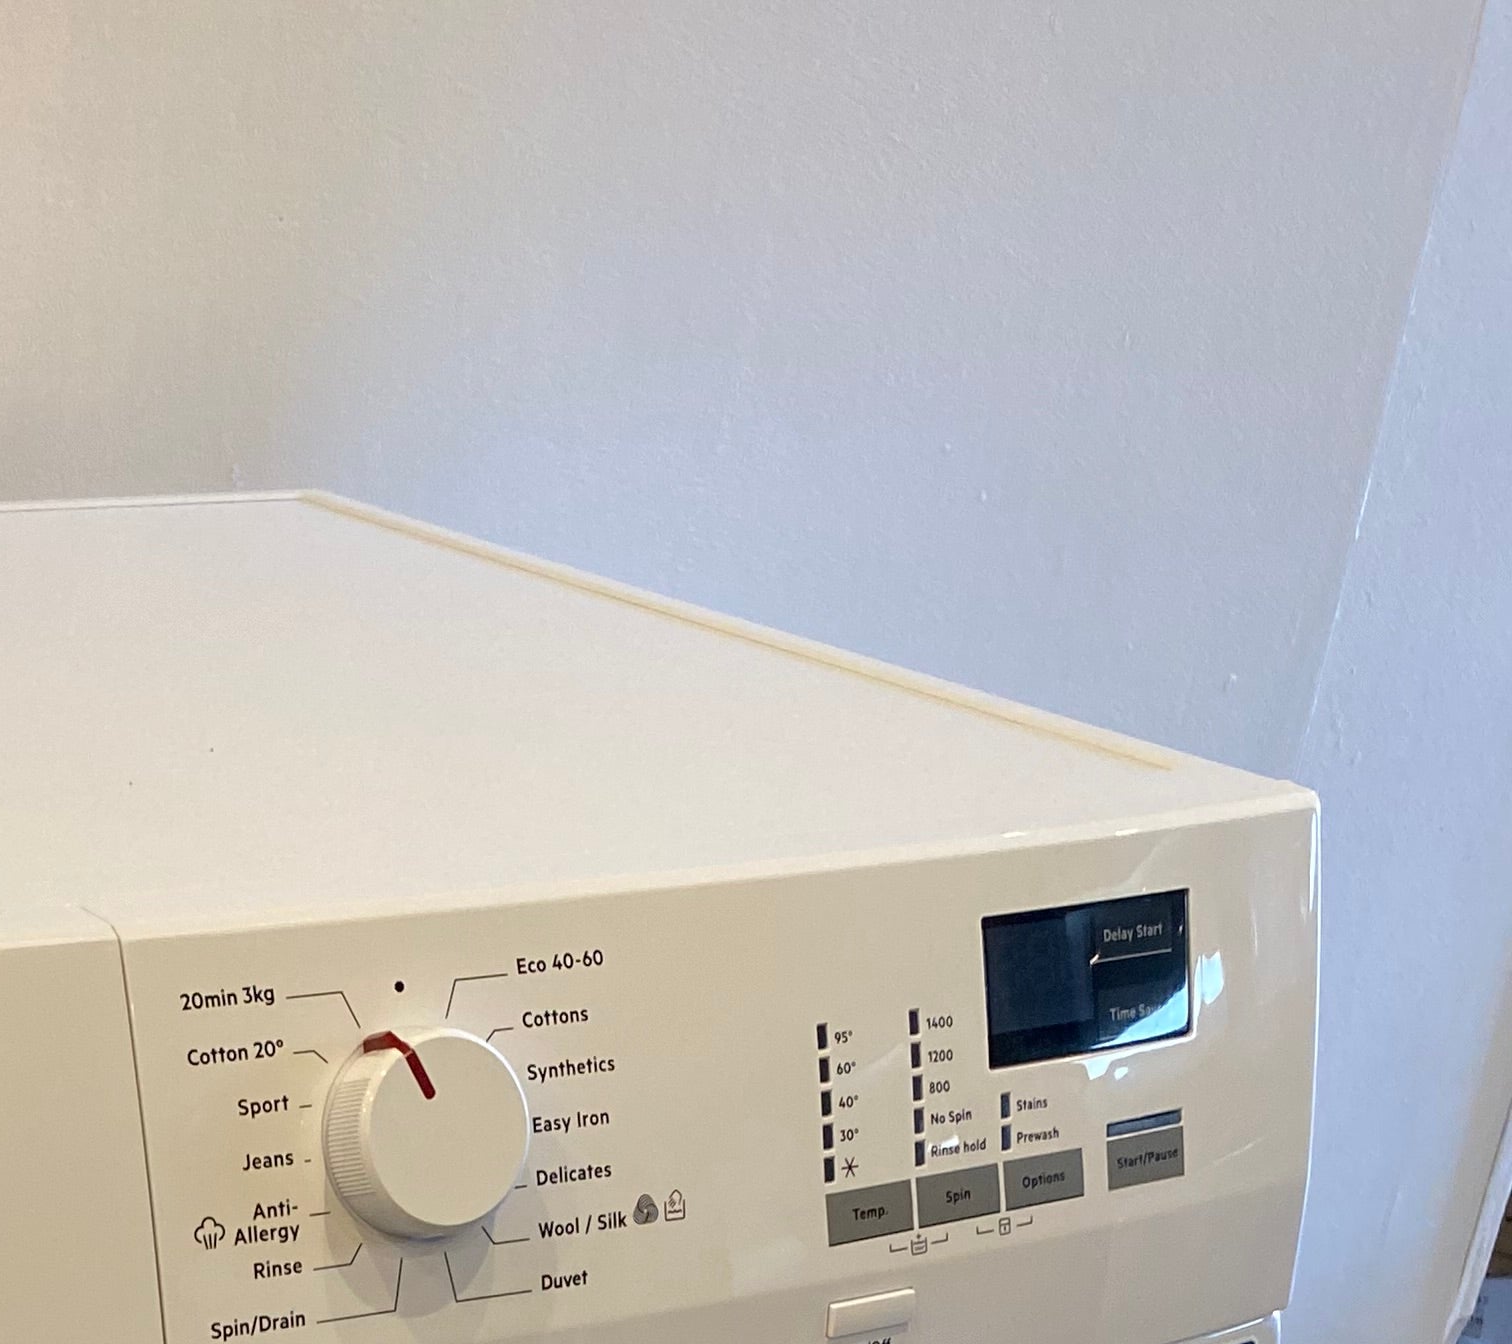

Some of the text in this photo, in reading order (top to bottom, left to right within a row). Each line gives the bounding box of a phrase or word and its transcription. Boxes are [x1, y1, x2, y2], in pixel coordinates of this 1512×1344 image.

[1104, 923, 1162, 942] Delay Start
[517, 950, 603, 974] Eco 40-60
[180, 985, 274, 1010] 20min 3kg
[523, 1010, 588, 1028] Cottons
[927, 1016, 953, 1029] 1400
[1110, 1007, 1136, 1021] Time
[835, 1031, 852, 1044] 95°
[188, 1040, 283, 1065] Cotton 20°
[928, 1049, 953, 1062] 1200
[528, 1056, 615, 1083] Synthetics
[837, 1062, 855, 1075] 60°
[930, 1080, 950, 1094] 800
[238, 1096, 288, 1118] Sport
[839, 1095, 858, 1108] 40°
[1017, 1098, 1047, 1111] Stains
[533, 1112, 609, 1133] Easy Iron
[931, 1109, 972, 1124] No Spin
[840, 1128, 858, 1142] 30°
[1017, 1127, 1059, 1144] Prewash
[931, 1138, 986, 1157] Rinse hold
[243, 1153, 293, 1171] Jeans
[1117, 1148, 1178, 1169] Start/Pause
[537, 1165, 611, 1186] Delicates
[1022, 1172, 1065, 1189] Options
[946, 1190, 970, 1203] Spin
[253, 1199, 299, 1220] Anti-
[852, 1207, 888, 1220] Temp.
[539, 1217, 579, 1238] Wool
[598, 1211, 627, 1230] Silk
[235, 1225, 299, 1246] Allergy
[254, 1261, 302, 1279] Rinse
[542, 1270, 587, 1290] Duvet
[211, 1311, 305, 1342] Spin/Drain
